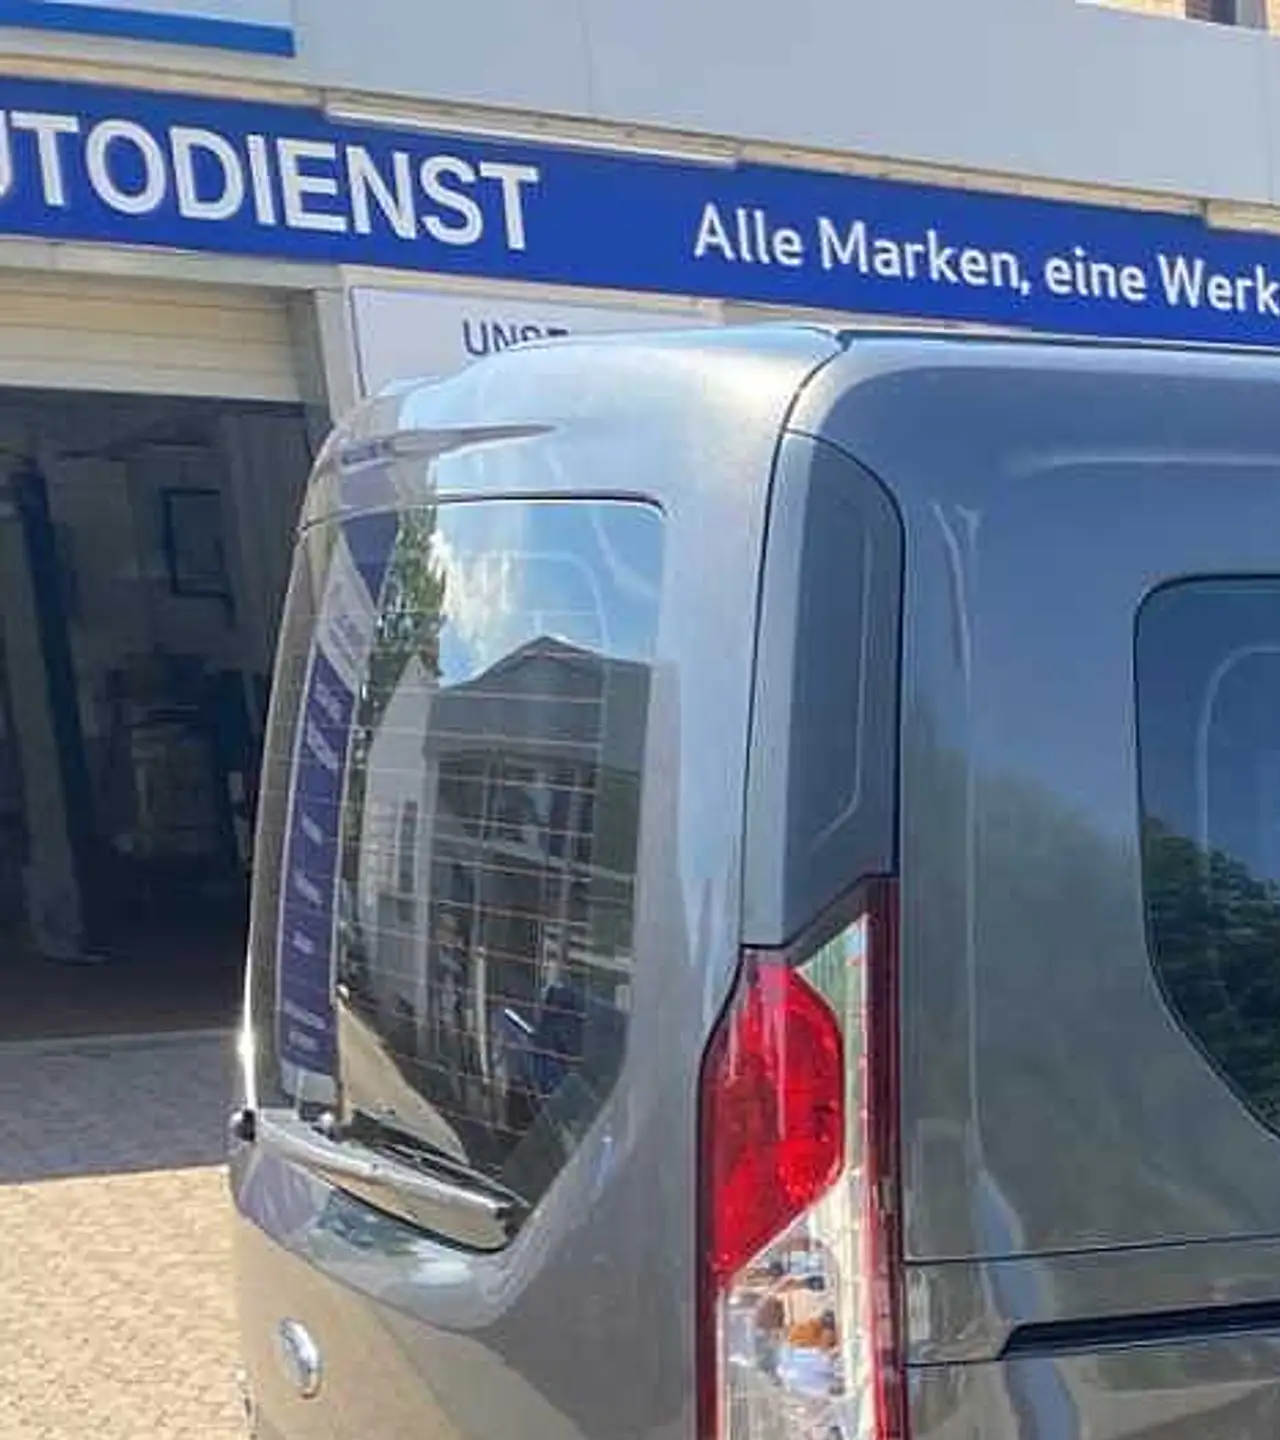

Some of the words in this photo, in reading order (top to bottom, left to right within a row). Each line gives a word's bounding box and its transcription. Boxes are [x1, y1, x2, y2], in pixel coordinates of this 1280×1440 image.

[0, 109, 538, 250] TODIENST
[693, 202, 804, 266] Alle
[816, 215, 1032, 297] Marken,
[1044, 246, 1148, 301] eine
